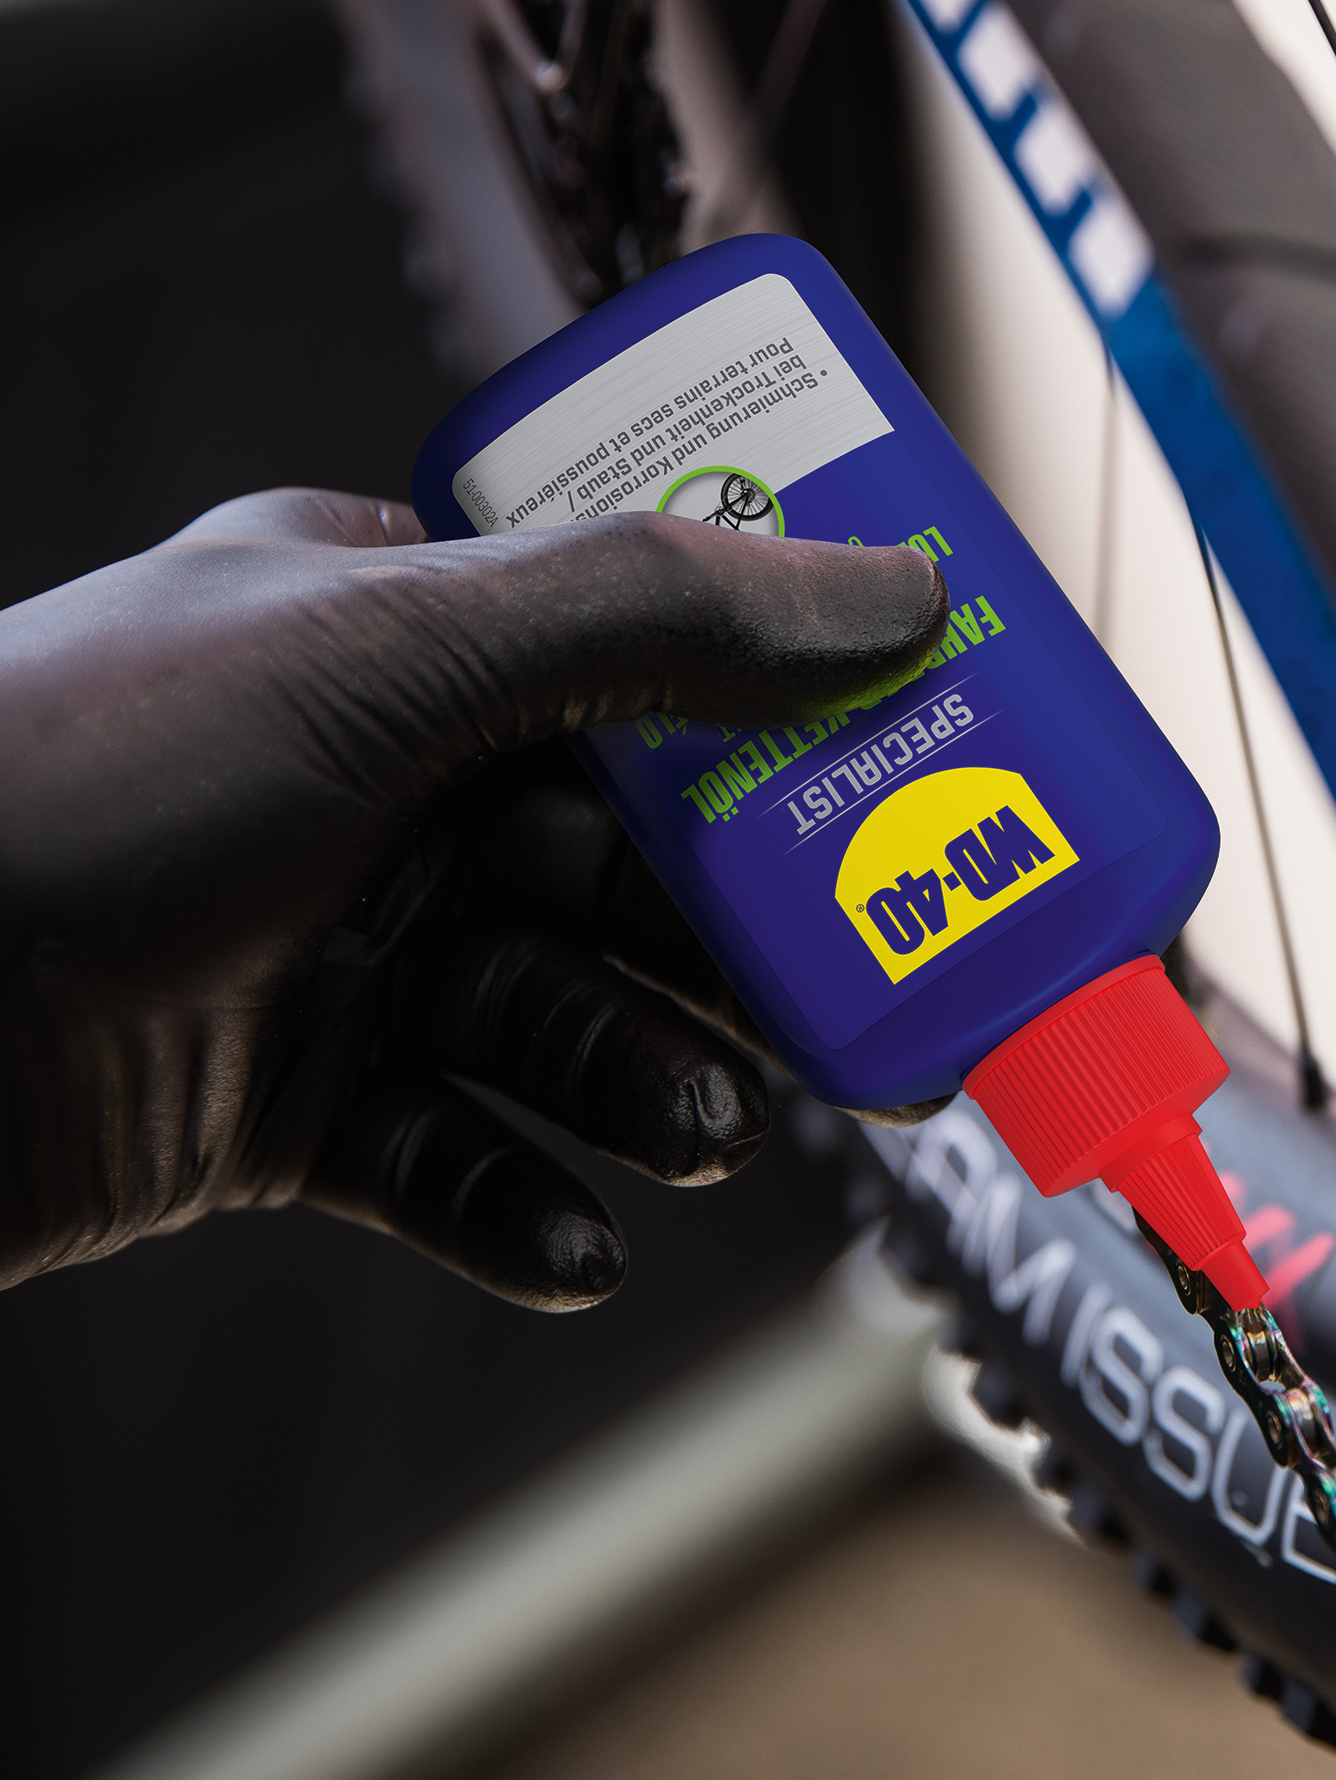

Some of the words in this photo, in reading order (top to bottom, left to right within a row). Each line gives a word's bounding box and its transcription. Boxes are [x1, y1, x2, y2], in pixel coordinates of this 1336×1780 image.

[748, 337, 795, 369] Pour
[777, 354, 807, 378] bei
[666, 371, 778, 442] Trockenheit
[673, 360, 747, 409] terrains
[707, 369, 819, 442] Schmierung
[608, 424, 631, 453] et
[630, 402, 674, 438] secs
[631, 429, 667, 457] und
[671, 436, 707, 467] und
[505, 441, 610, 528] poussiéreux
[575, 455, 632, 501] Staub
[462, 478, 499, 528] 51-00302A
[787, 694, 974, 835] SPECIALIST
[866, 804, 1056, 956] WD-40
